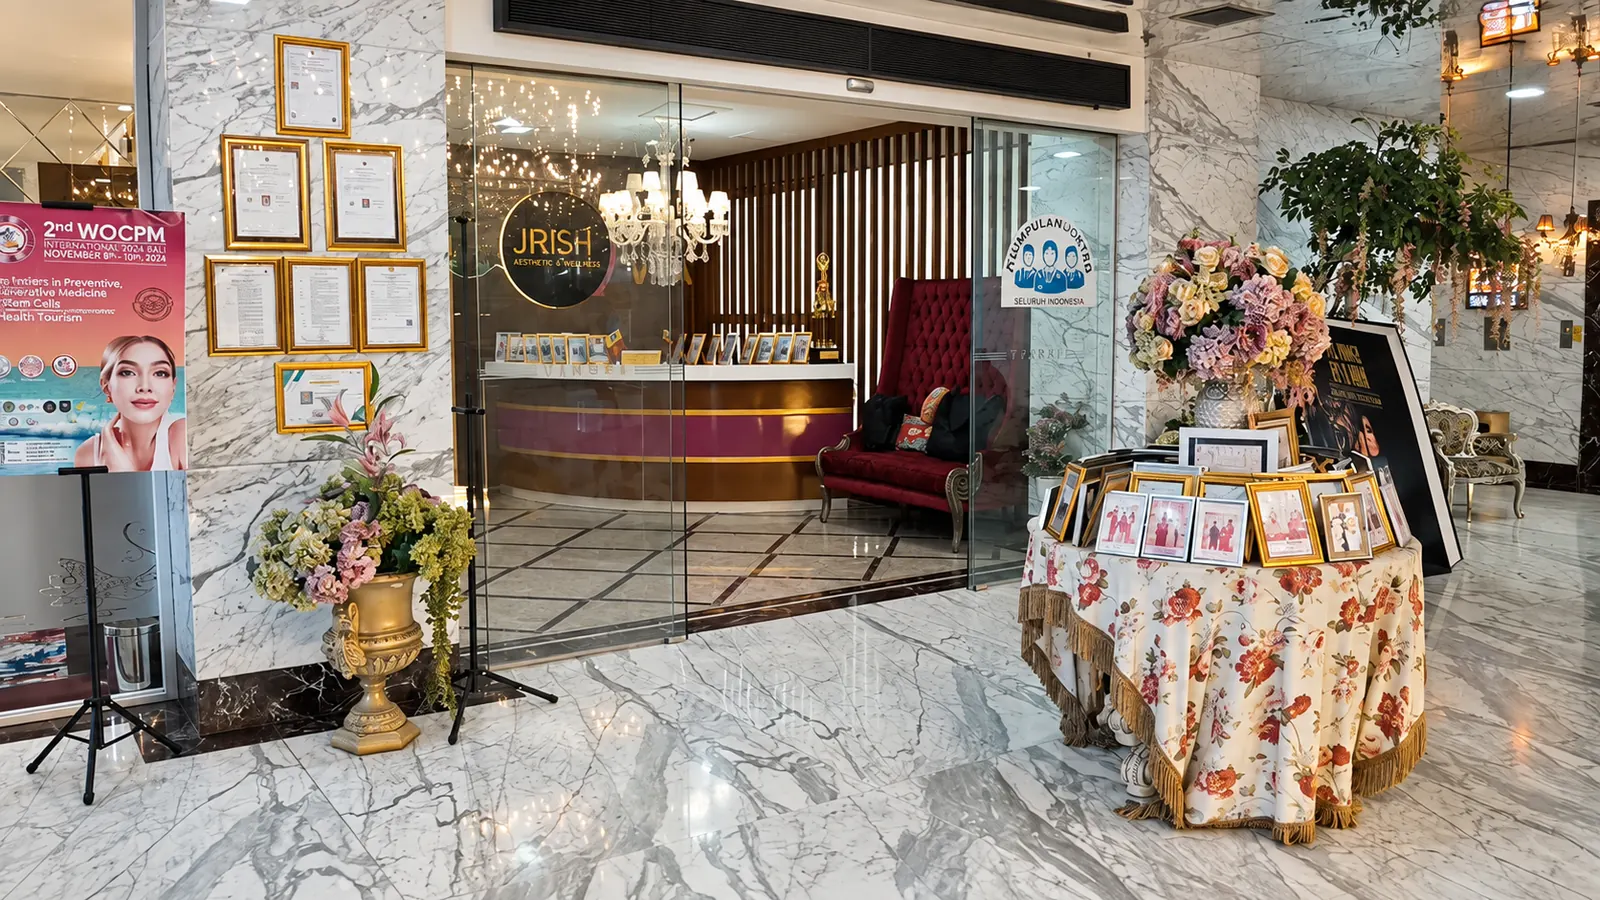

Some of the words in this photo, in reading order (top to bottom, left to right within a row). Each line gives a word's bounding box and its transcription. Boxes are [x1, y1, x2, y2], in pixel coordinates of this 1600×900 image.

[43, 220, 73, 238] 2nd
[77, 222, 166, 243] WOCPM
[44, 240, 119, 252] INTERNATIONAL
[513, 226, 592, 256] JRISH
[44, 249, 101, 260] NOVEMBER
[145, 254, 167, 263] 2024
[513, 259, 553, 267] AESTHETIC
[564, 260, 601, 268] WELLNESS
[52, 277, 61, 287] in
[64, 278, 123, 289] Preventive,
[58, 288, 107, 298] Medicine
[33, 298, 61, 309] Cells
[1014, 297, 1046, 305] SELURUH
[1048, 297, 1085, 305] INDONESIA
[37, 312, 83, 322] Tourism
